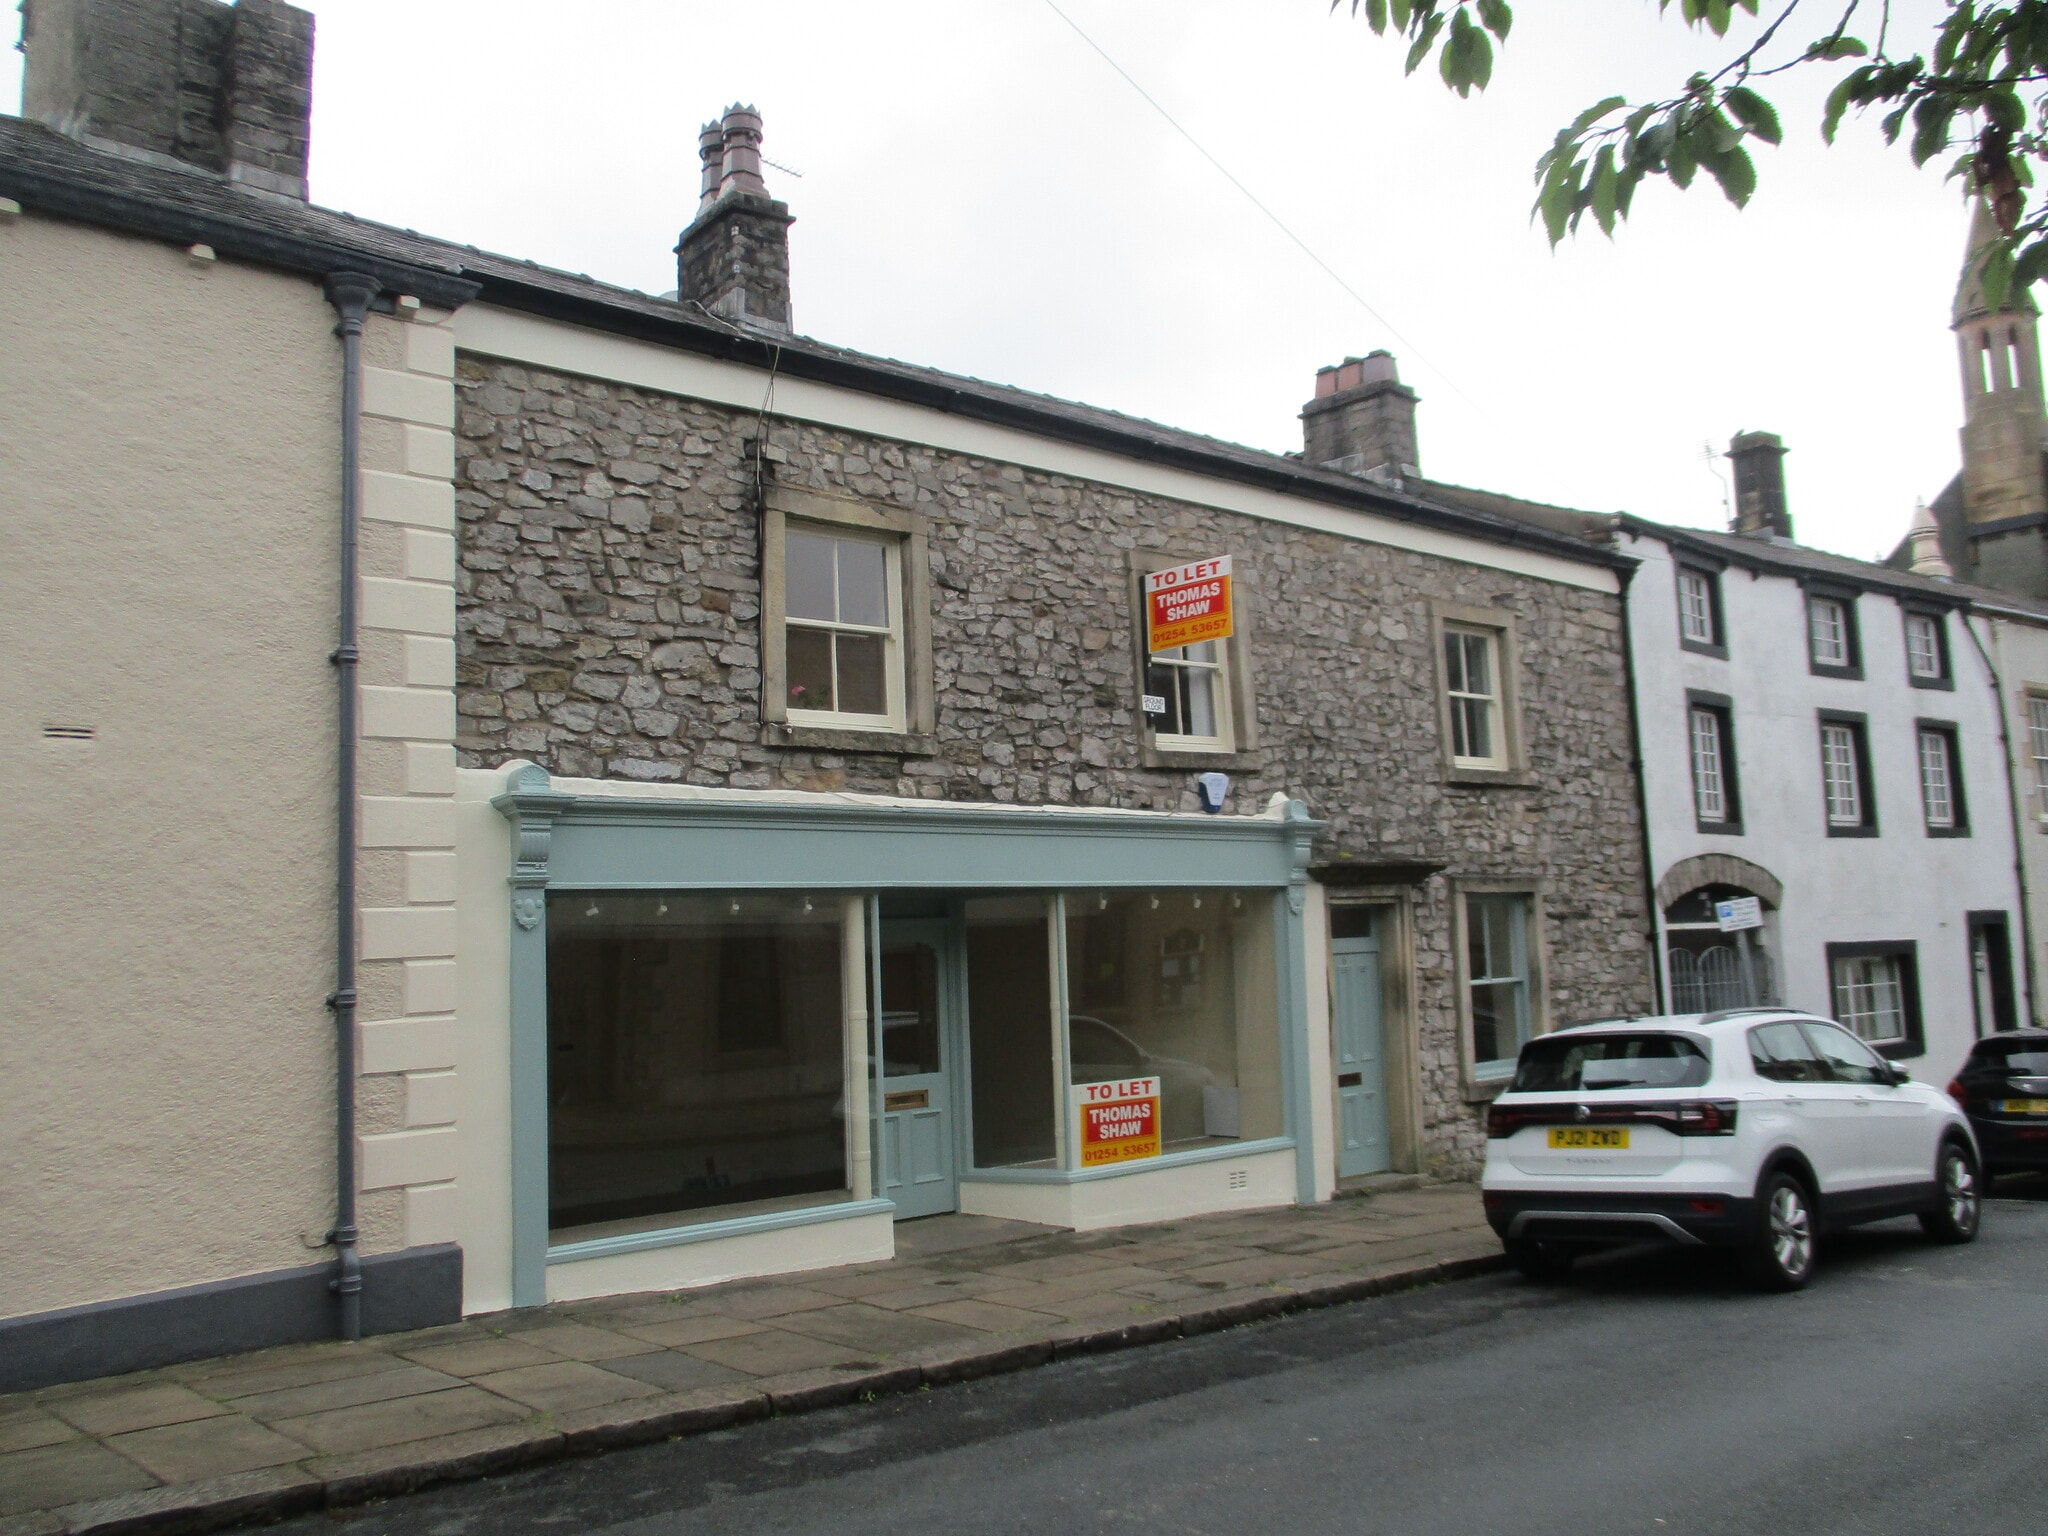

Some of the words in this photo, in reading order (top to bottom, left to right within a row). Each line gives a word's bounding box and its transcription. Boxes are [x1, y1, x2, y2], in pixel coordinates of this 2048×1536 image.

[1153, 571, 1177, 588] TO
[1184, 561, 1220, 581] LET
[1157, 582, 1220, 608] THOMAS
[1167, 600, 1210, 621] SHAW
[1153, 630, 1186, 643] 01254
[1191, 618, 1227, 634] 53657
[1087, 1084, 1112, 1100] TO
[1119, 1080, 1152, 1097] LET
[1089, 1103, 1151, 1123] THOMAS
[1100, 1121, 1141, 1139] SHAW
[1085, 1148, 1118, 1161] 01254
[1123, 1142, 1156, 1155] 53657
